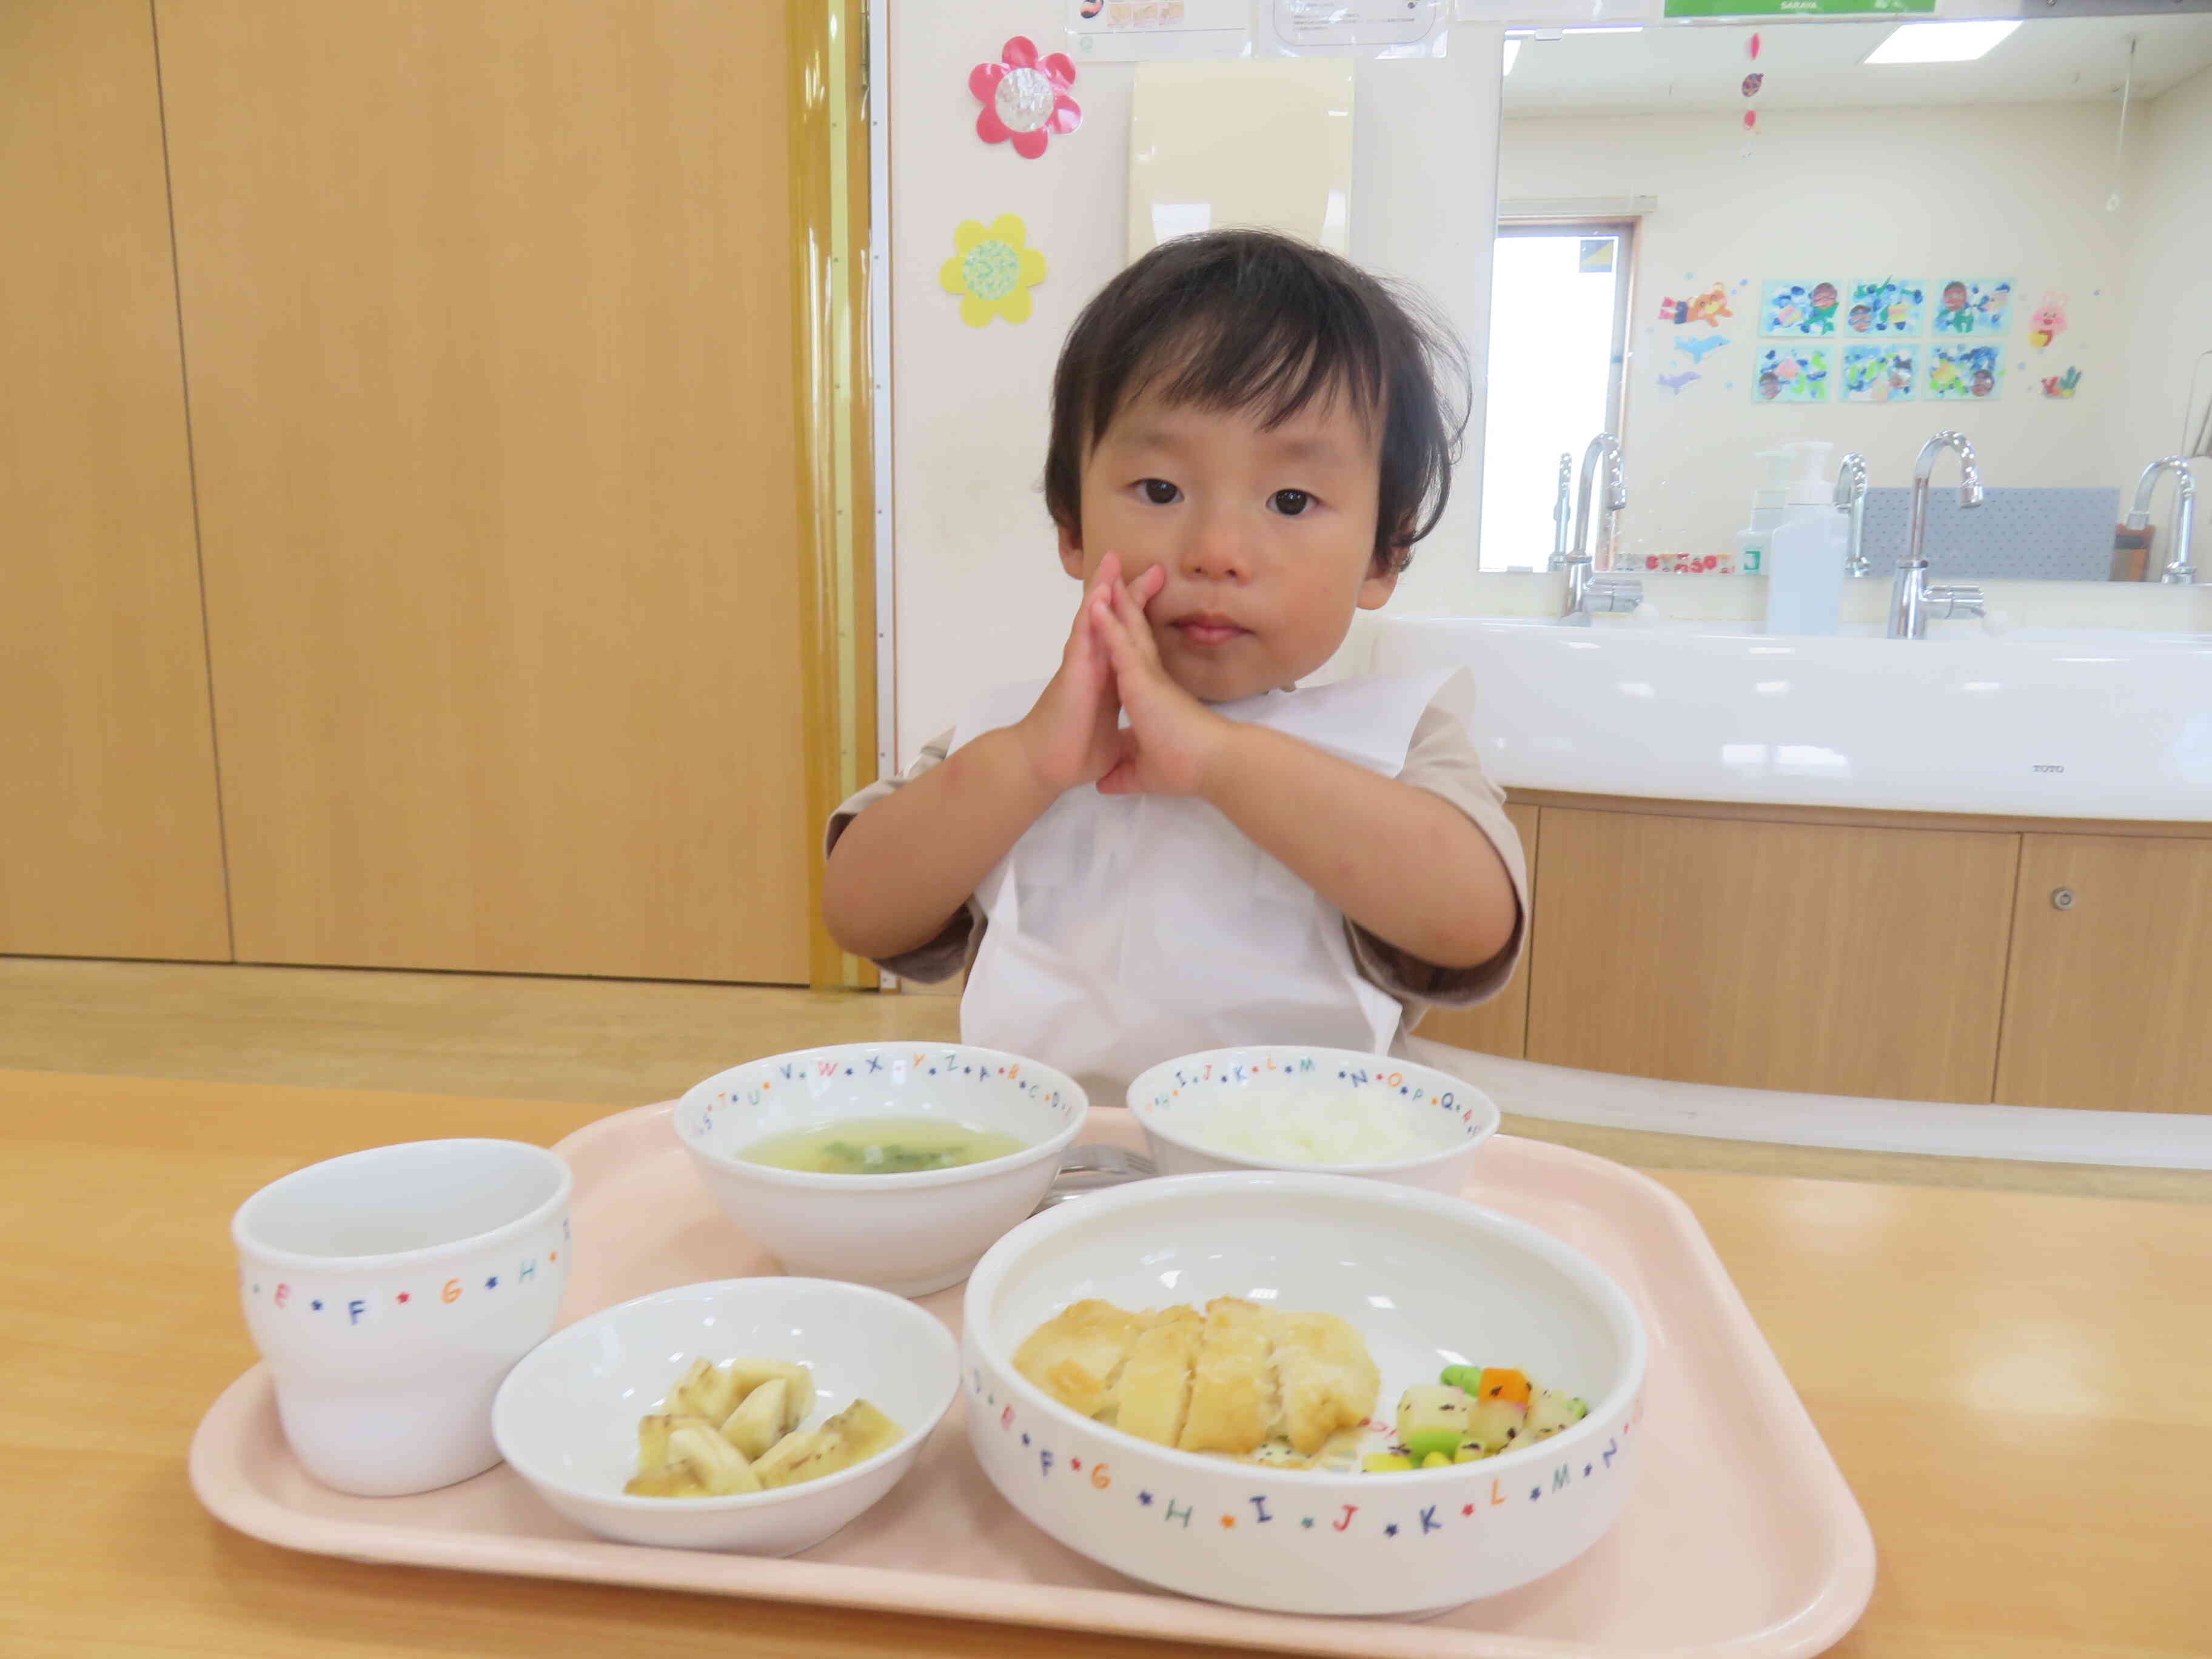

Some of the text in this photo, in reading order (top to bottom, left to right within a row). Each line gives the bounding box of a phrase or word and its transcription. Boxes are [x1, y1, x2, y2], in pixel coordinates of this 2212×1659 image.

[748, 1090, 760, 1106] U
[780, 1063, 792, 1080] V
[817, 1062, 839, 1077] W
[865, 1056, 883, 1074] X
[912, 1054, 927, 1068] Y
[945, 1054, 959, 1071] Z
[1175, 1071, 1187, 1087] I
[1202, 1064, 1212, 1081] J
[1233, 1065, 1247, 1082] K
[1267, 1056, 1276, 1070] L
[1299, 1059, 1315, 1072] M
[1350, 1070, 1368, 1088] N
[1387, 1072, 1403, 1087] O
[1441, 1092, 1454, 1110] Q
[349, 1300, 366, 1326] F
[441, 1278, 463, 1304] G
[518, 1259, 537, 1283] H
[1091, 1463, 1111, 1490] G
[1165, 1498, 1193, 1529] H
[1249, 1495, 1272, 1523] I
[1333, 1504, 1359, 1531] J
[1419, 1504, 1441, 1535] K
[1490, 1479, 1507, 1505] L
[1552, 1464, 1570, 1493] M
